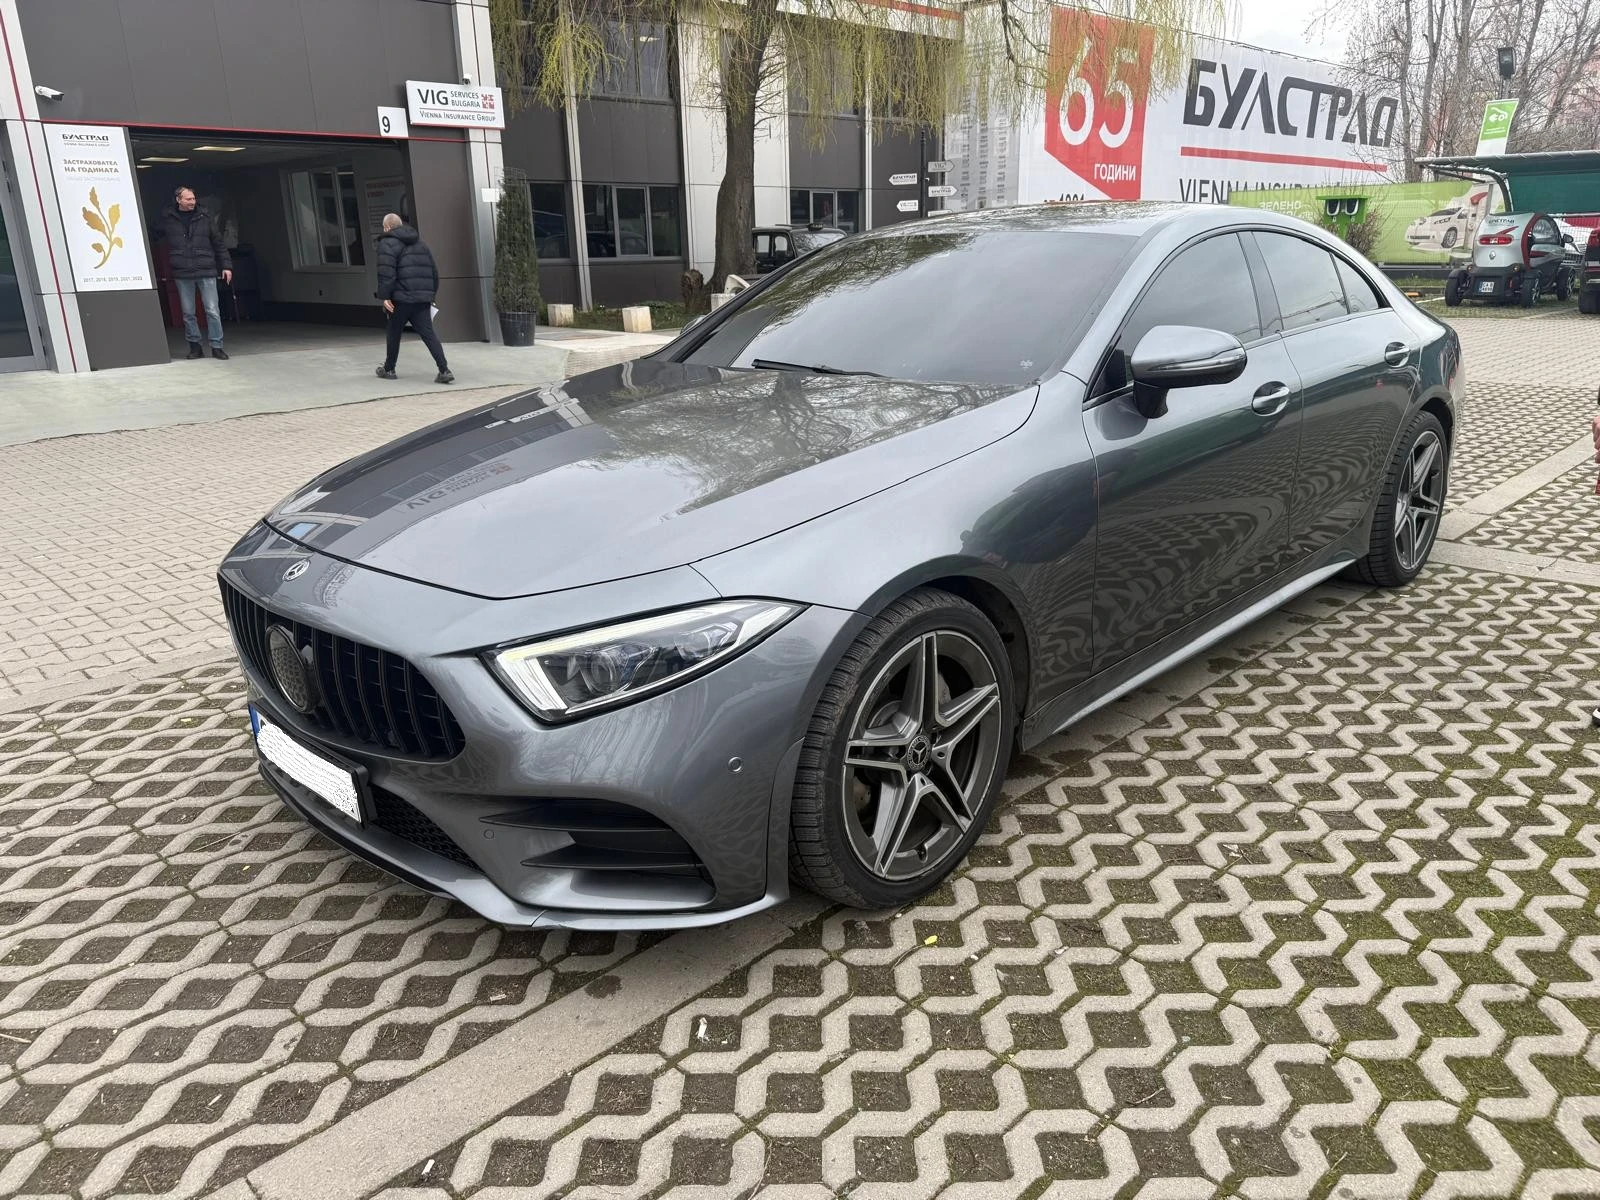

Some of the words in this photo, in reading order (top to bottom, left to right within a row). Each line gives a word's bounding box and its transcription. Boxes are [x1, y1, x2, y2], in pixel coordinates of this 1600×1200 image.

[417, 88, 449, 106] VIG
[450, 90, 479, 100] SERVICES
[1059, 36, 1135, 149] 65
[451, 99, 481, 108] BULGARIA
[1182, 57, 1399, 149] БУЛСТРАД
[381, 115, 391, 134] 9
[62, 133, 109, 141] БУЛСТРАД
[1094, 163, 1137, 183] ГОДИНИ
